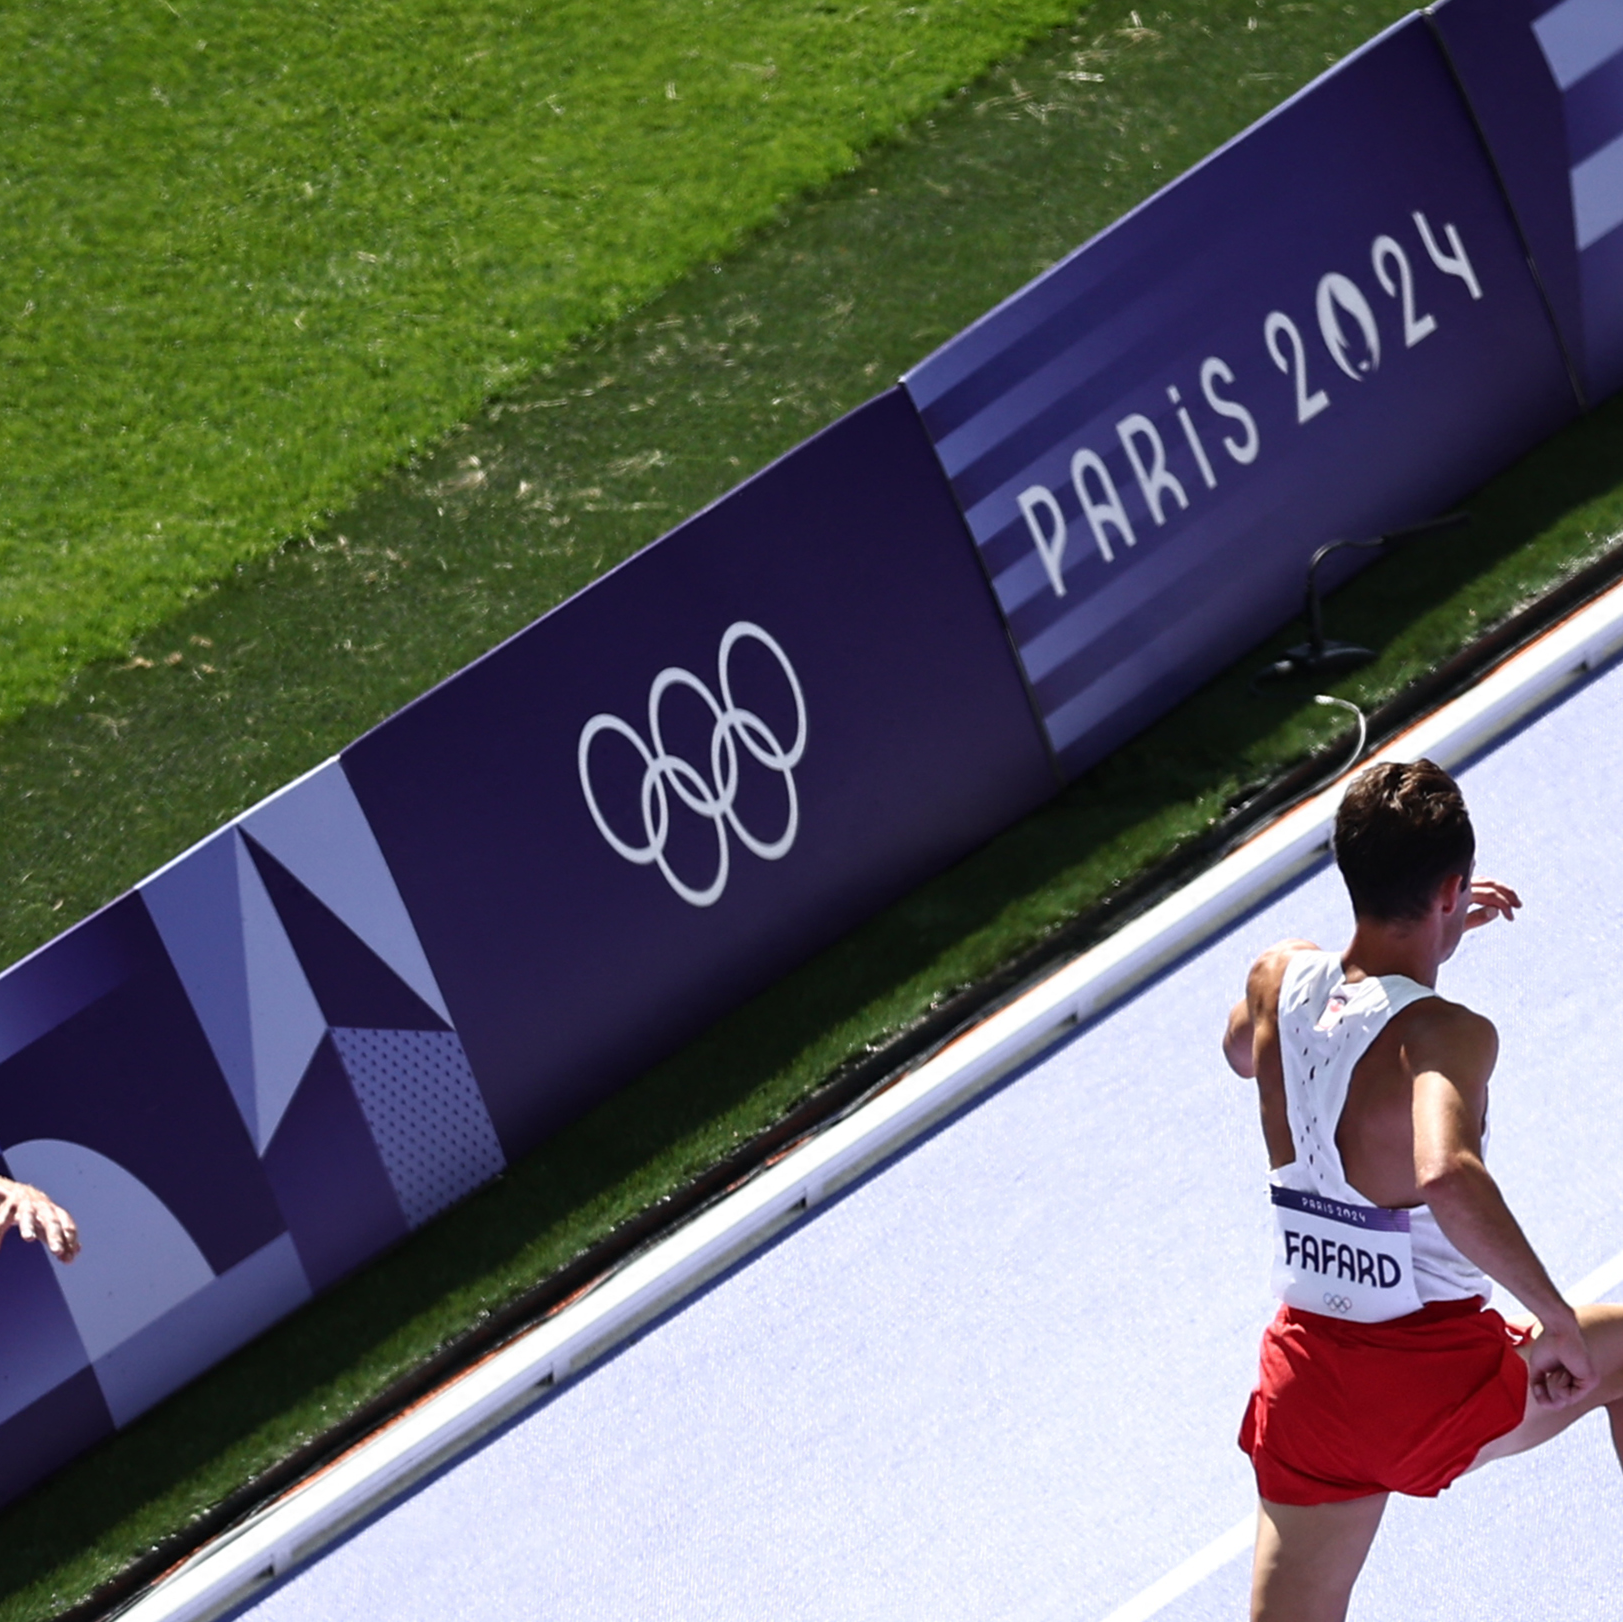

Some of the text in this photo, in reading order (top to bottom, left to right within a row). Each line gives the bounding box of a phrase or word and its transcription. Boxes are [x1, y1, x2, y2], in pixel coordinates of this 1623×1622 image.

[1264, 211, 1482, 424] 2024
[1335, 1207, 1366, 1223] 2024
[1284, 1230, 1401, 1288] FAFARD
